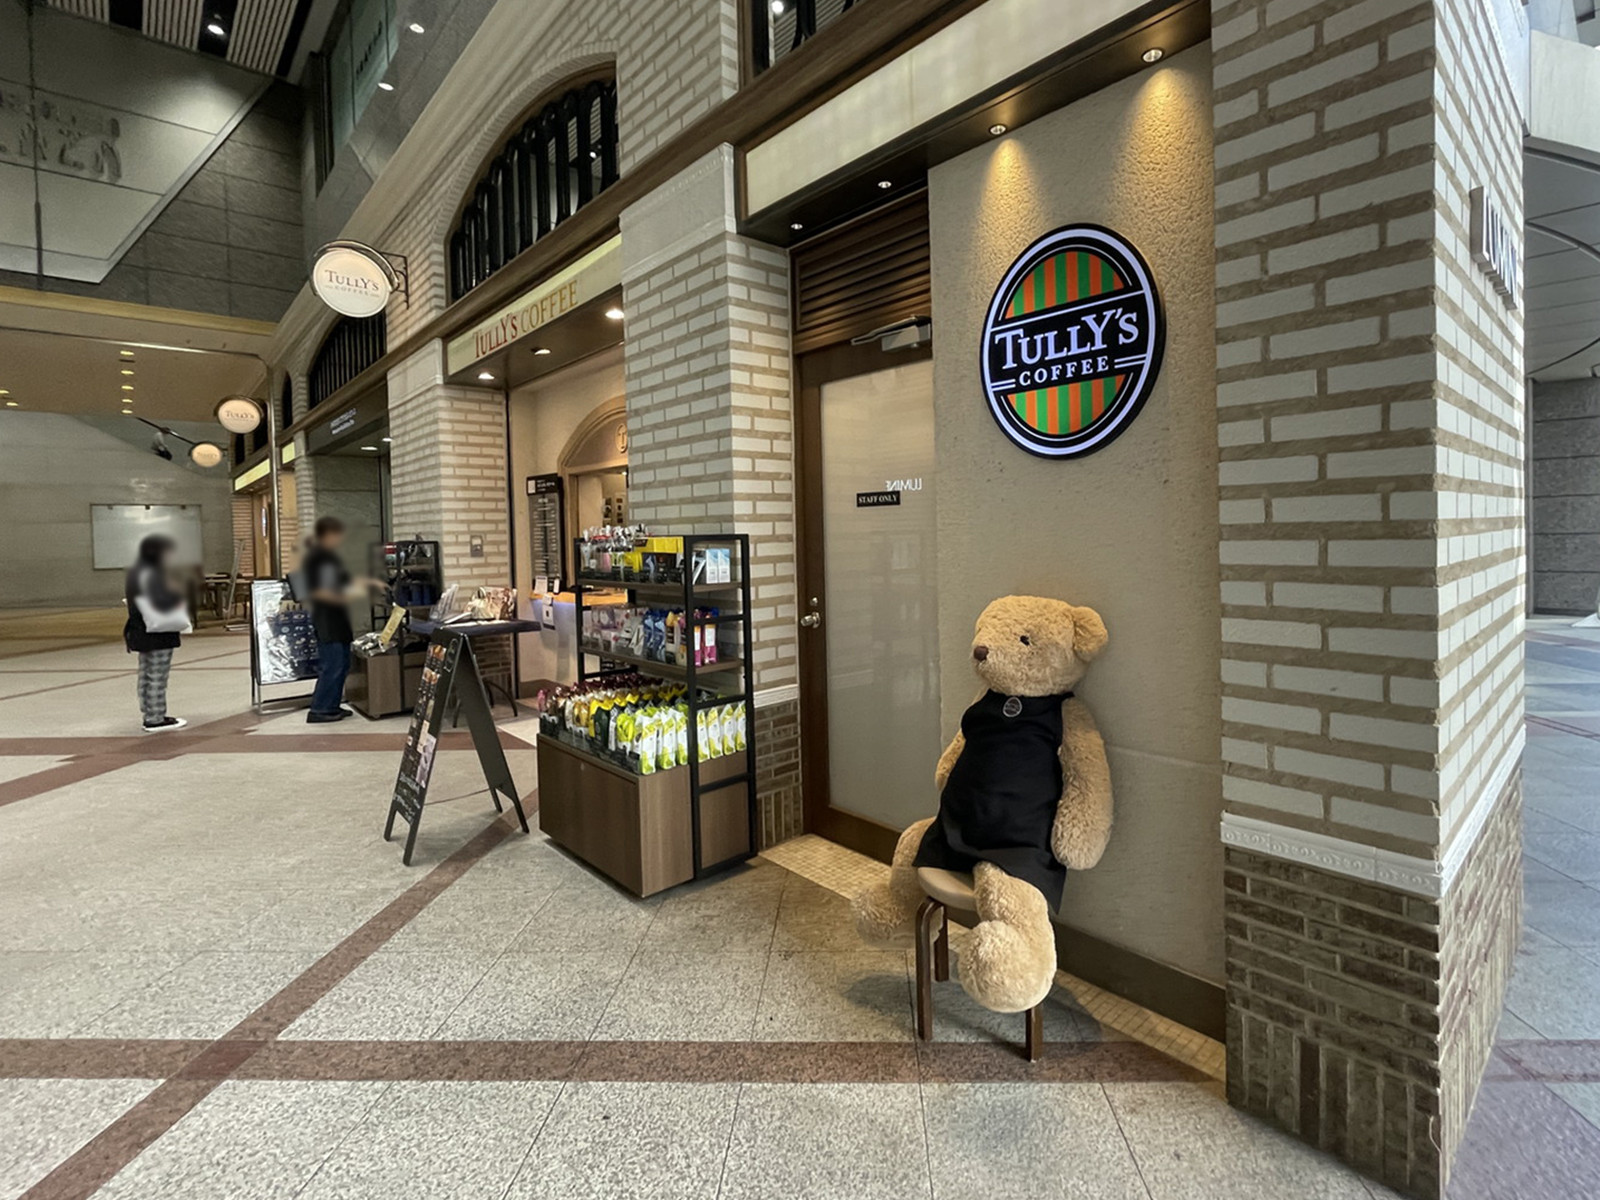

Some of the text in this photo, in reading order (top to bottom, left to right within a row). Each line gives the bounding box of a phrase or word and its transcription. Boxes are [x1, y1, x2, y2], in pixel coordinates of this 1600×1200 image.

[325, 270, 380, 291] TULLY'S
[473, 280, 578, 358] TULLY'S COFFEE
[994, 308, 1139, 369] TULLY'S
[1019, 355, 1110, 386] COFFEE
[858, 494, 898, 504] STAFF ONLY
